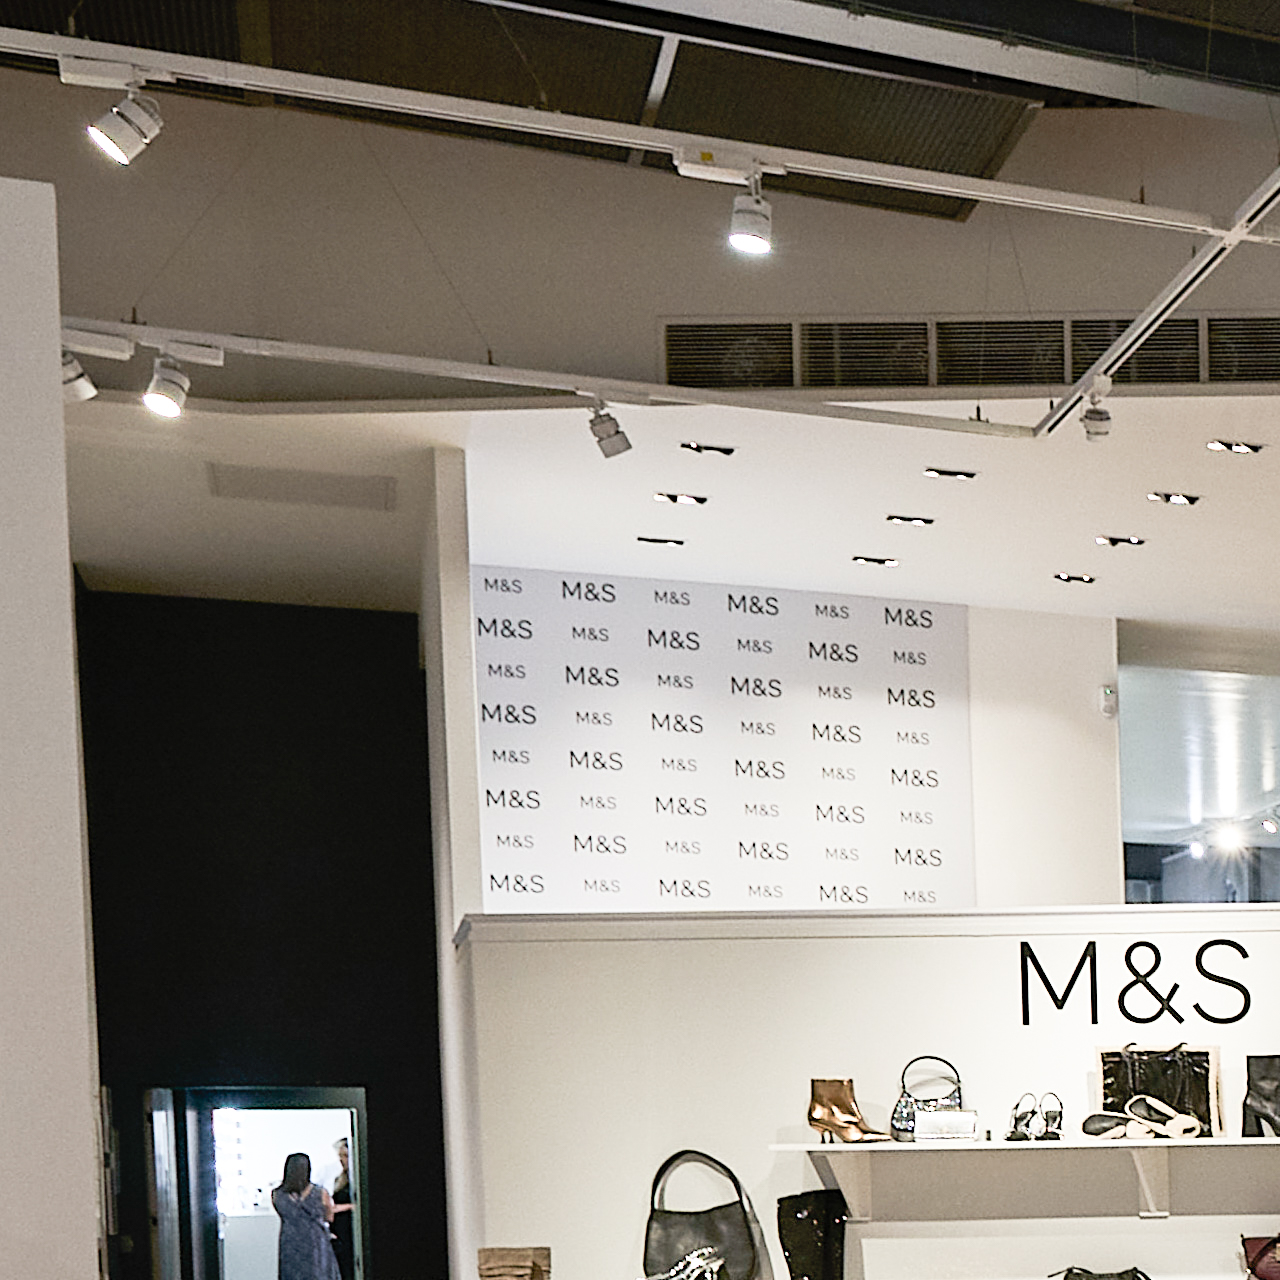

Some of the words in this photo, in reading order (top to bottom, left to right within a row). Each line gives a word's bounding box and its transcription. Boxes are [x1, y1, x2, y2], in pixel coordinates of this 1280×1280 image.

[483, 577, 523, 595] M&S
[561, 579, 617, 604] M&S
[653, 589, 691, 607] M&S
[727, 593, 780, 617] M&S
[814, 603, 850, 620] M&S
[884, 606, 934, 630] M&S
[476, 616, 534, 640] M&S
[571, 625, 610, 643] M&S
[647, 628, 701, 652] M&S
[736, 637, 773, 655] M&S
[808, 640, 859, 664] M&S
[892, 650, 927, 666] M&S
[487, 663, 527, 680] M&S
[565, 664, 620, 688] M&S
[656, 673, 694, 690] M&S
[730, 675, 783, 699] M&S
[817, 685, 853, 701] M&S
[886, 687, 936, 709] M&S
[480, 702, 537, 726] M&S
[575, 710, 613, 727] M&S
[650, 712, 704, 735] M&S
[740, 720, 776, 736] M&S
[811, 722, 862, 744] M&S
[896, 730, 930, 746] M&S
[491, 749, 531, 765] M&S
[569, 749, 624, 771] M&S
[661, 757, 698, 773] M&S
[734, 758, 786, 780] M&S
[821, 766, 856, 782] M&S
[890, 767, 940, 789] M&S
[485, 788, 541, 810] M&S
[579, 795, 617, 810] M&S
[654, 795, 708, 817] M&S
[744, 803, 780, 818] M&S
[815, 803, 866, 825] M&S
[899, 810, 934, 825] M&S
[496, 834, 535, 849] M&S
[573, 833, 628, 855] M&S
[664, 840, 702, 855] M&S
[738, 840, 790, 861] M&S
[824, 846, 860, 862] M&S
[894, 847, 943, 868] M&S
[489, 873, 545, 894] M&S
[583, 878, 621, 893] M&S
[658, 878, 712, 899] M&S
[747, 884, 784, 899] M&S
[818, 884, 869, 904] M&S
[903, 890, 937, 904] M&S
[1020, 939, 1251, 1026] M&S
